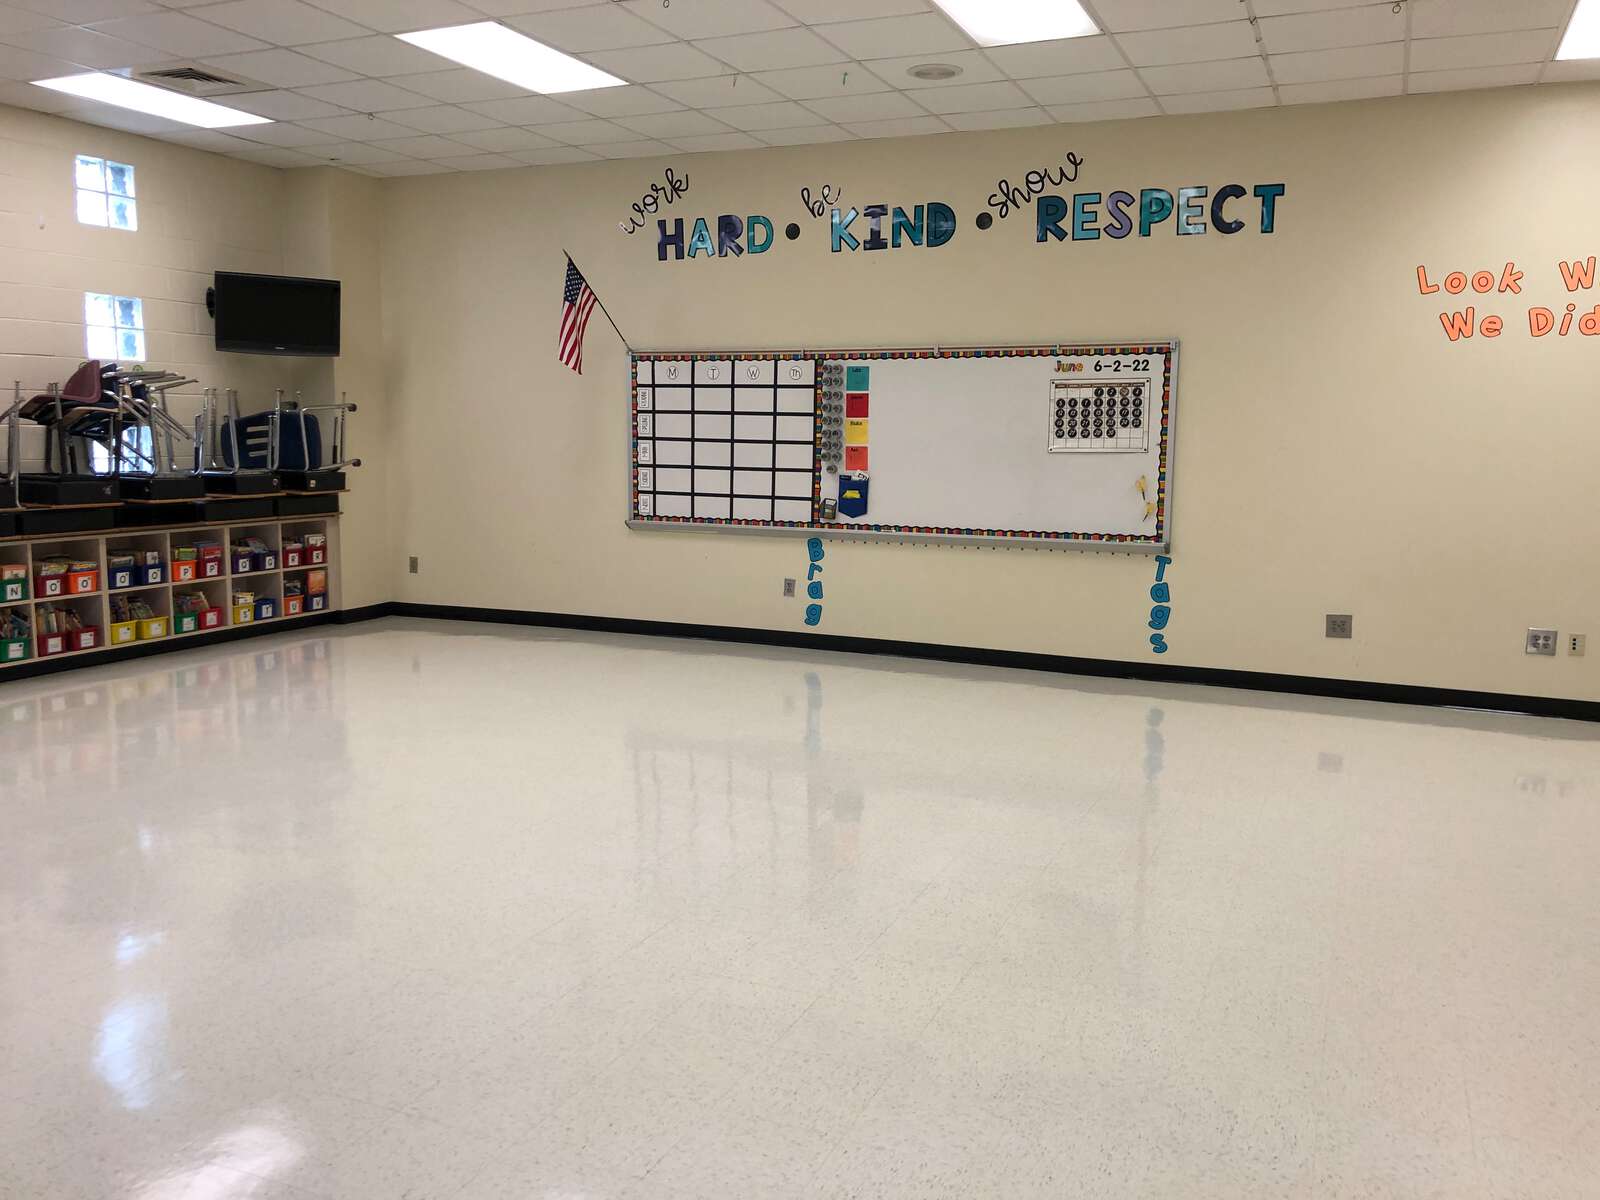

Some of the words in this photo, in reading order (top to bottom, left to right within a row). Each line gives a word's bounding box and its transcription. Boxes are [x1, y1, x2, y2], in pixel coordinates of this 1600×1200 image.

[616, 167, 689, 235] work
[801, 184, 842, 218] be
[987, 151, 1084, 218] show
[656, 214, 774, 261] HARD
[830, 202, 957, 253] KIND
[1036, 183, 1285, 242] RESPECT
[1416, 262, 1524, 295] Look
[1558, 256, 1600, 292] W
[1439, 306, 1504, 341] We
[1528, 303, 1600, 337] Did
[748, 368, 759, 378] W
[1053, 360, 1083, 373] June
[1093, 359, 1150, 372] 6-2-22
[804, 537, 825, 626] Brag
[1148, 555, 1172, 653] Tags
